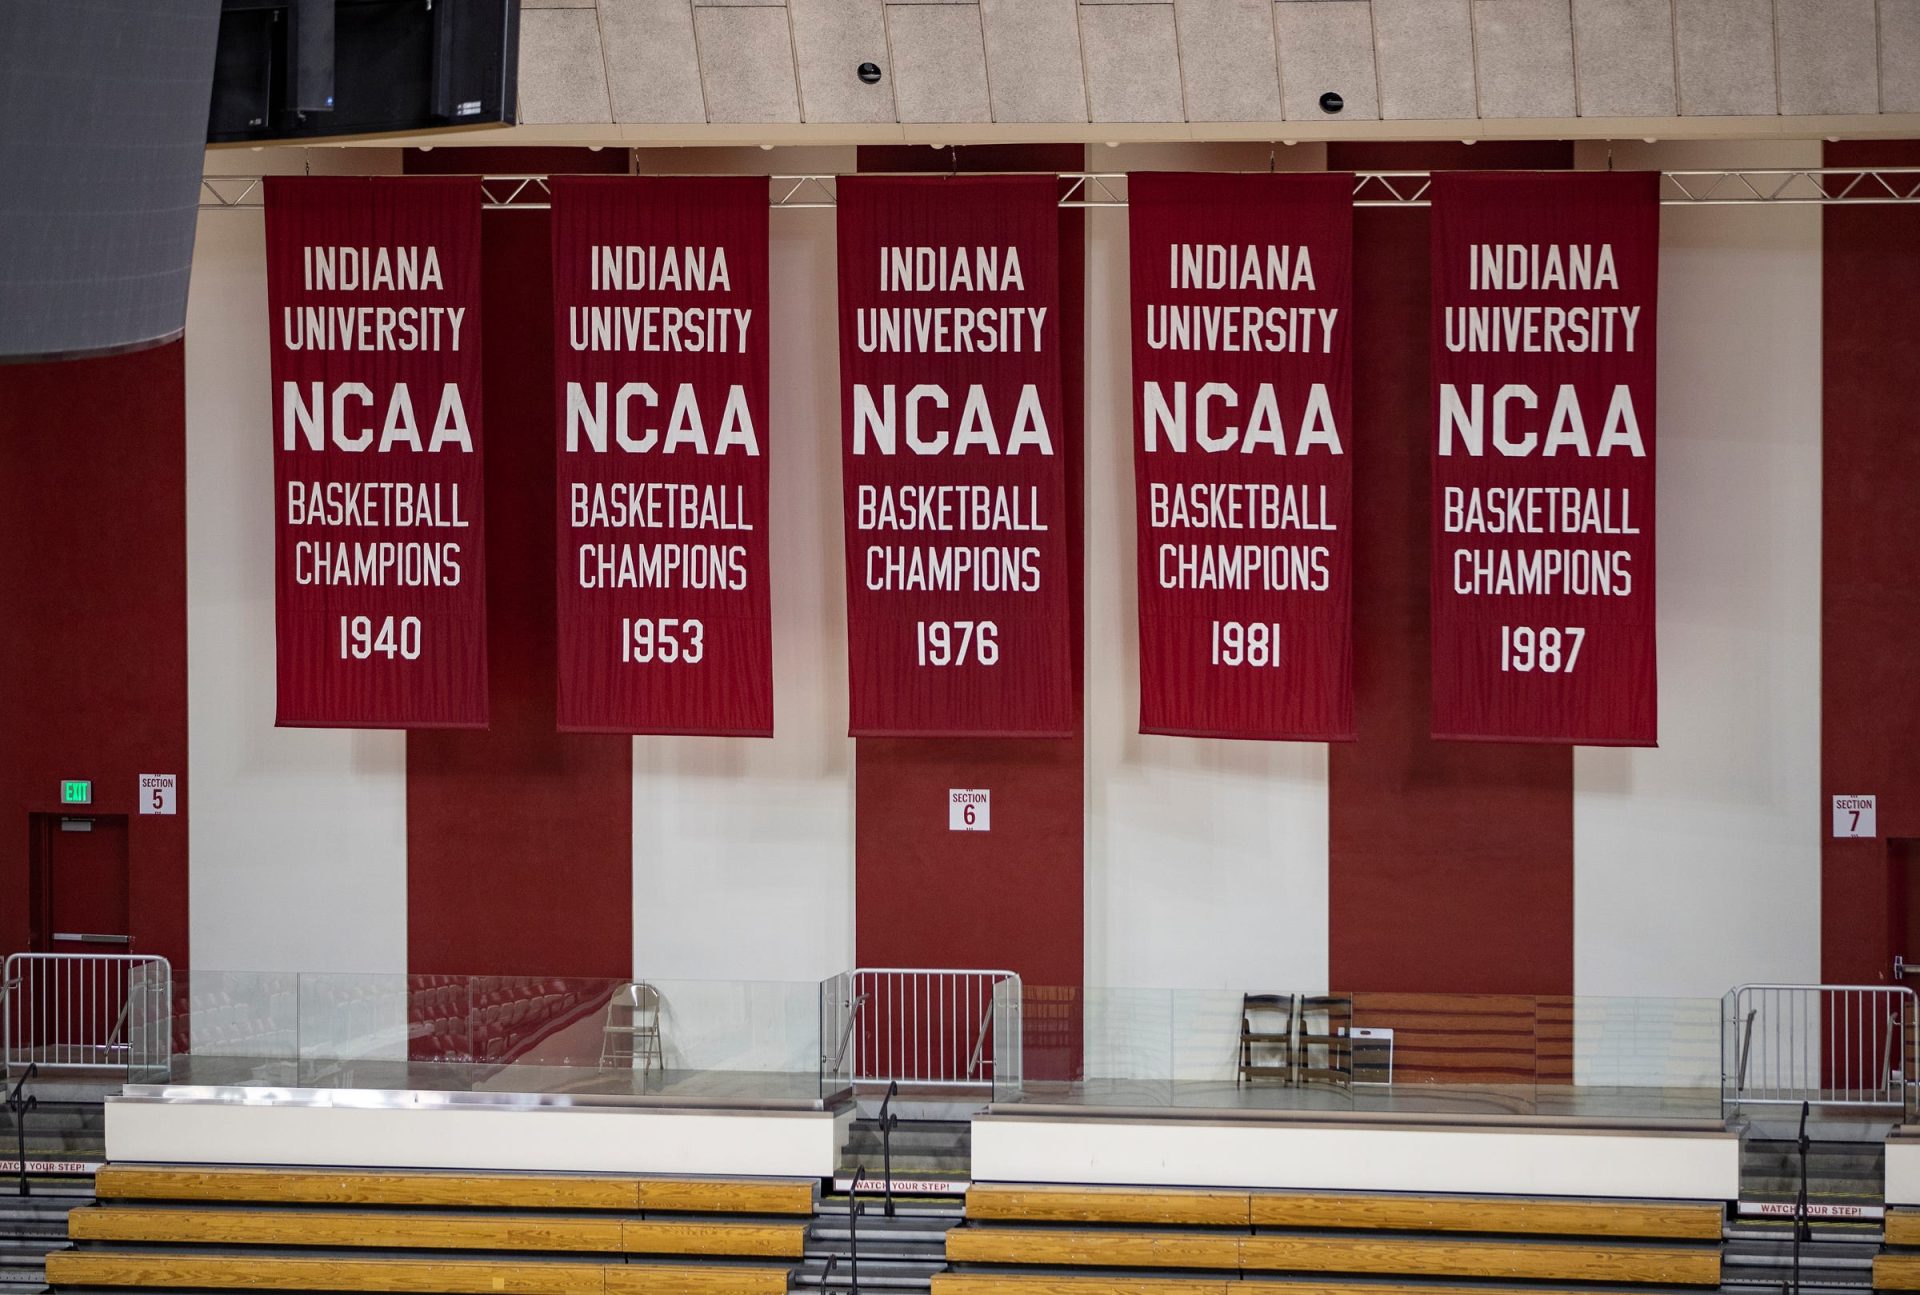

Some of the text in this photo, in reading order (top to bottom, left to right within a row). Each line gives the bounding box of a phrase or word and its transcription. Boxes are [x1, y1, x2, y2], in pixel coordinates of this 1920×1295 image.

[304, 246, 444, 291] INDIANA
[591, 245, 731, 292] INDIANA
[880, 246, 1025, 292] INDIANA
[1170, 243, 1316, 291] INDIANA
[1470, 243, 1619, 290] INDIANA
[284, 306, 466, 352] UNIVERSITY
[570, 306, 752, 354] UNIVERSITY
[857, 307, 1047, 353] UNIVERSITY
[1147, 304, 1338, 354] UNIVERSITY
[1445, 305, 1641, 353] UNIVERSITY
[283, 381, 474, 453] NCAA
[566, 381, 760, 456] NCAA
[853, 383, 1054, 456] NCAA
[1143, 381, 1344, 456] NCAA
[1438, 383, 1646, 457] NCAA
[288, 480, 469, 527] BASKETBALL
[571, 482, 754, 531] BASKETBALL
[858, 485, 1048, 531] BASKETBALL
[1150, 482, 1337, 531] BASKETBALL
[1444, 486, 1640, 534] BASKETBALL
[296, 541, 461, 587] CHAMPIONS
[579, 543, 747, 591] CHAMPIONS
[866, 545, 1041, 592] CHAMPIONS
[1159, 543, 1330, 592] CHAMPIONS
[1454, 548, 1632, 596] CHAMPIONS
[340, 615, 421, 660] 1940
[622, 618, 704, 664] 1953
[917, 620, 999, 666] 1976
[1212, 620, 1280, 668] 1981
[1501, 625, 1586, 673] 1987
[65, 782, 88, 801] EXIT
[142, 779, 174, 788] SECTION
[152, 788, 163, 809] 5
[952, 793, 987, 803] SECTION
[1836, 799, 1873, 809] SECTION
[963, 803, 976, 825] 6
[1848, 810, 1860, 832] 7
[0, 1162, 85, 1171] ATC YOUR STEP!
[892, 1182, 918, 1190] YOUR
[921, 1183, 950, 1191] STEP!
[1803, 1206, 1829, 1215] OUR
[1832, 1206, 1862, 1216] STEP!
